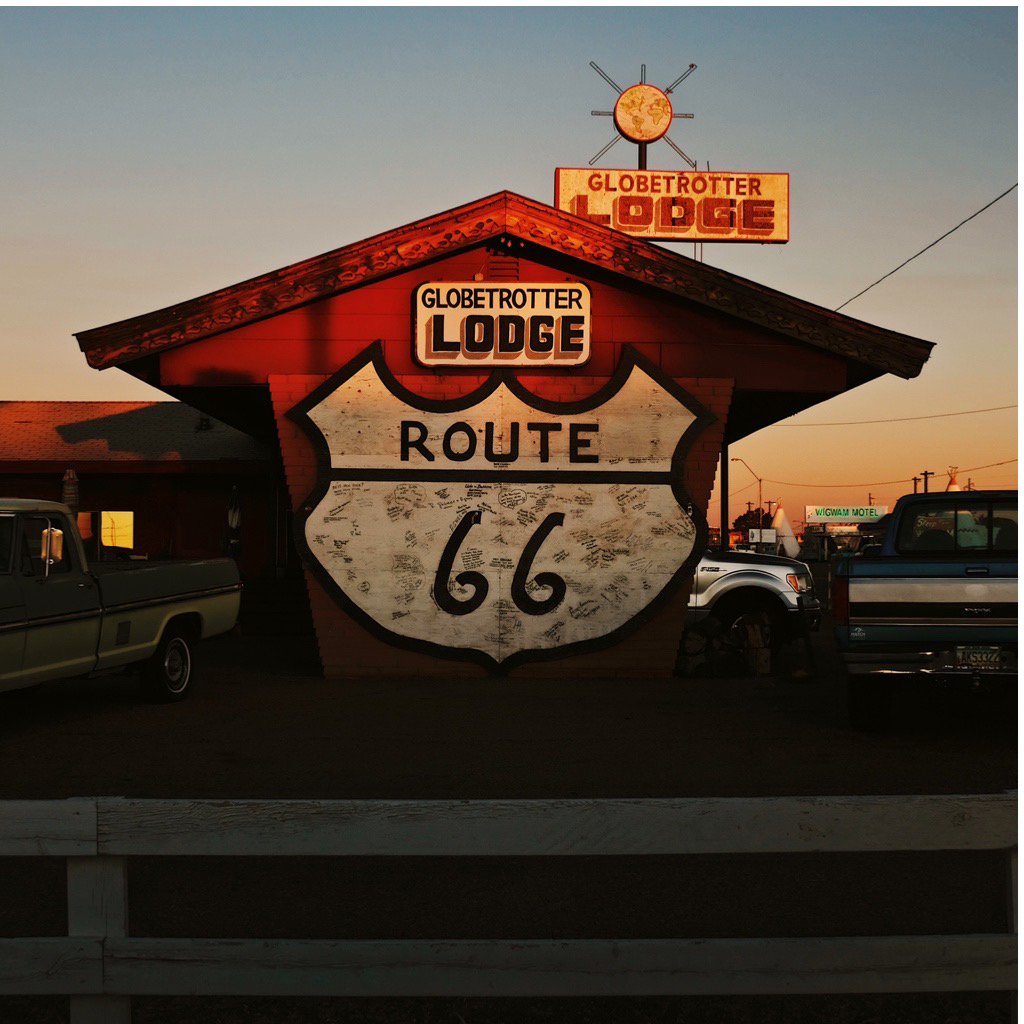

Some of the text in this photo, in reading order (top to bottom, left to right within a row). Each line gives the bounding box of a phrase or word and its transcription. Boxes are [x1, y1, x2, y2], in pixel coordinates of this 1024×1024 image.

[587, 173, 762, 196] GLOBETROTTER
[570, 194, 776, 233] LODGE
[421, 287, 583, 310] GLOBETROTTER
[428, 314, 586, 356] LODGE
[400, 420, 600, 464] ROUTE
[815, 508, 879, 517] WIGWAM MOTEL
[433, 510, 567, 616] 66
